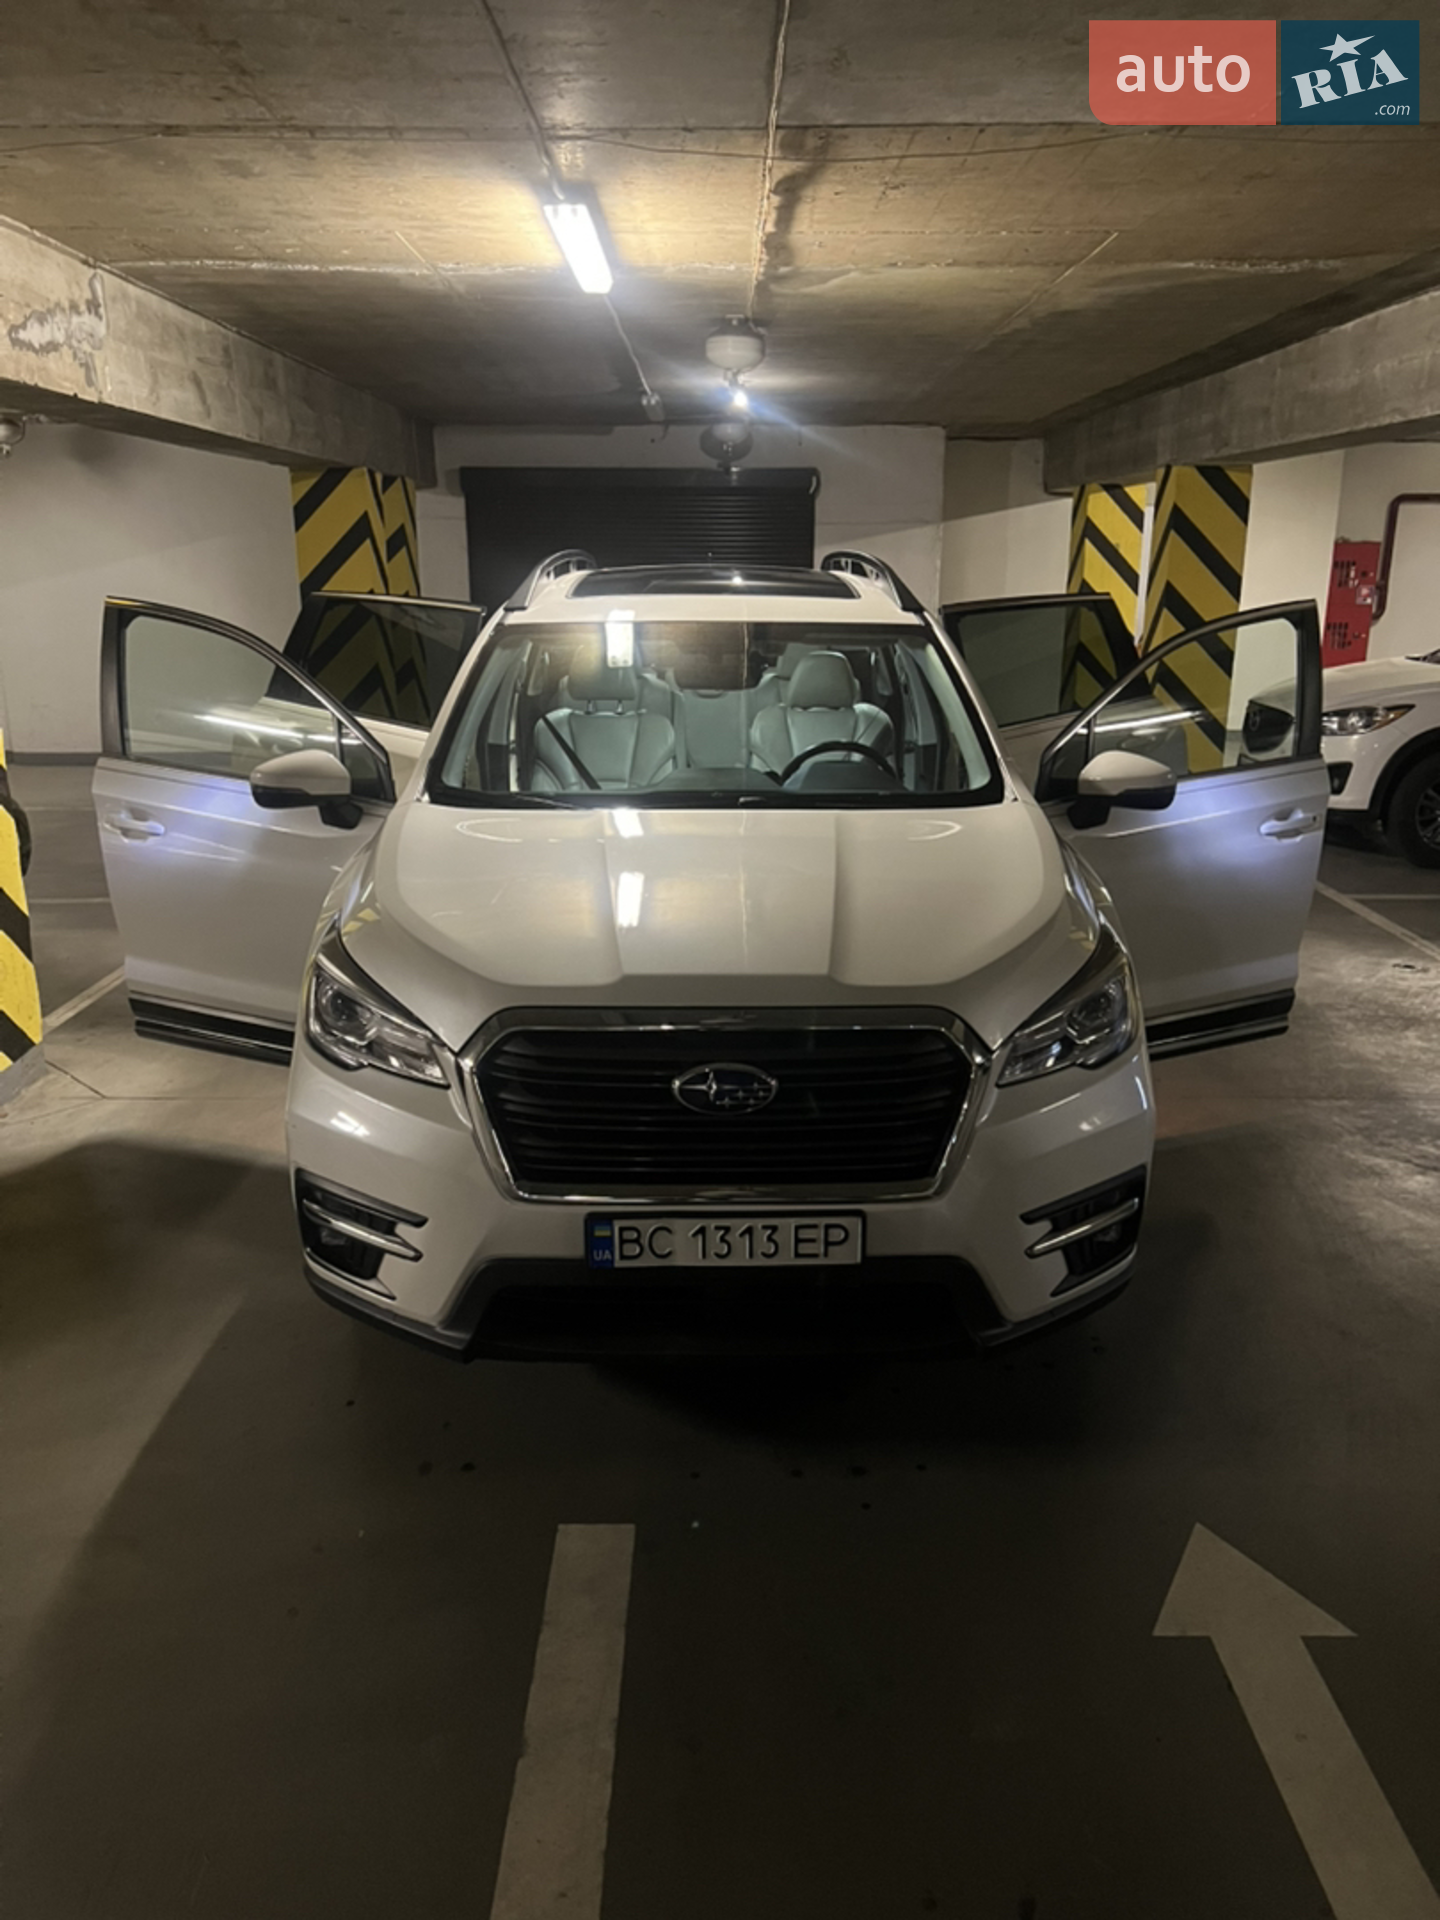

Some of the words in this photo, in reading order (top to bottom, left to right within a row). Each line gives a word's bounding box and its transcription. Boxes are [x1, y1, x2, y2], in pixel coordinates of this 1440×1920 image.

[617, 1225, 673, 1260] BC
[688, 1224, 779, 1260] 1313
[793, 1223, 849, 1258] EP
[593, 1249, 613, 1261] UA
